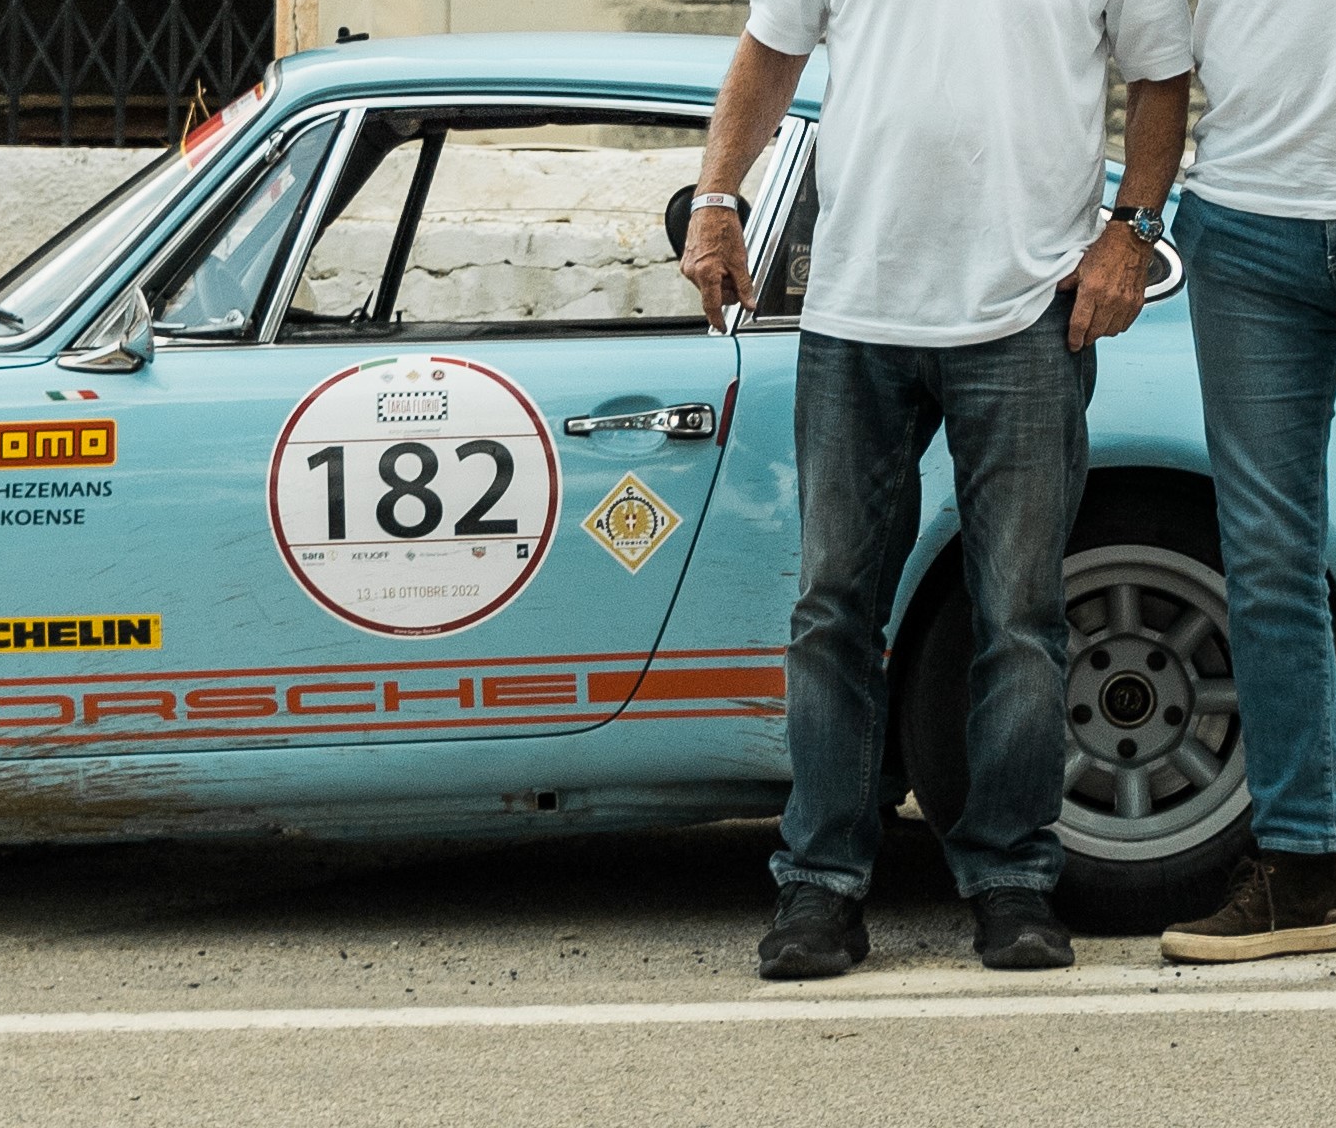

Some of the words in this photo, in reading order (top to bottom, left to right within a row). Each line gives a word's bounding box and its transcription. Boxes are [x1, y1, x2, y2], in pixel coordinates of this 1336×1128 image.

[306, 439, 519, 541] 182
[0, 508, 86, 526] KOENSE
[382, 586, 396, 600] 16
[399, 584, 449, 599] OTTOBRE
[451, 583, 480, 597] 2022
